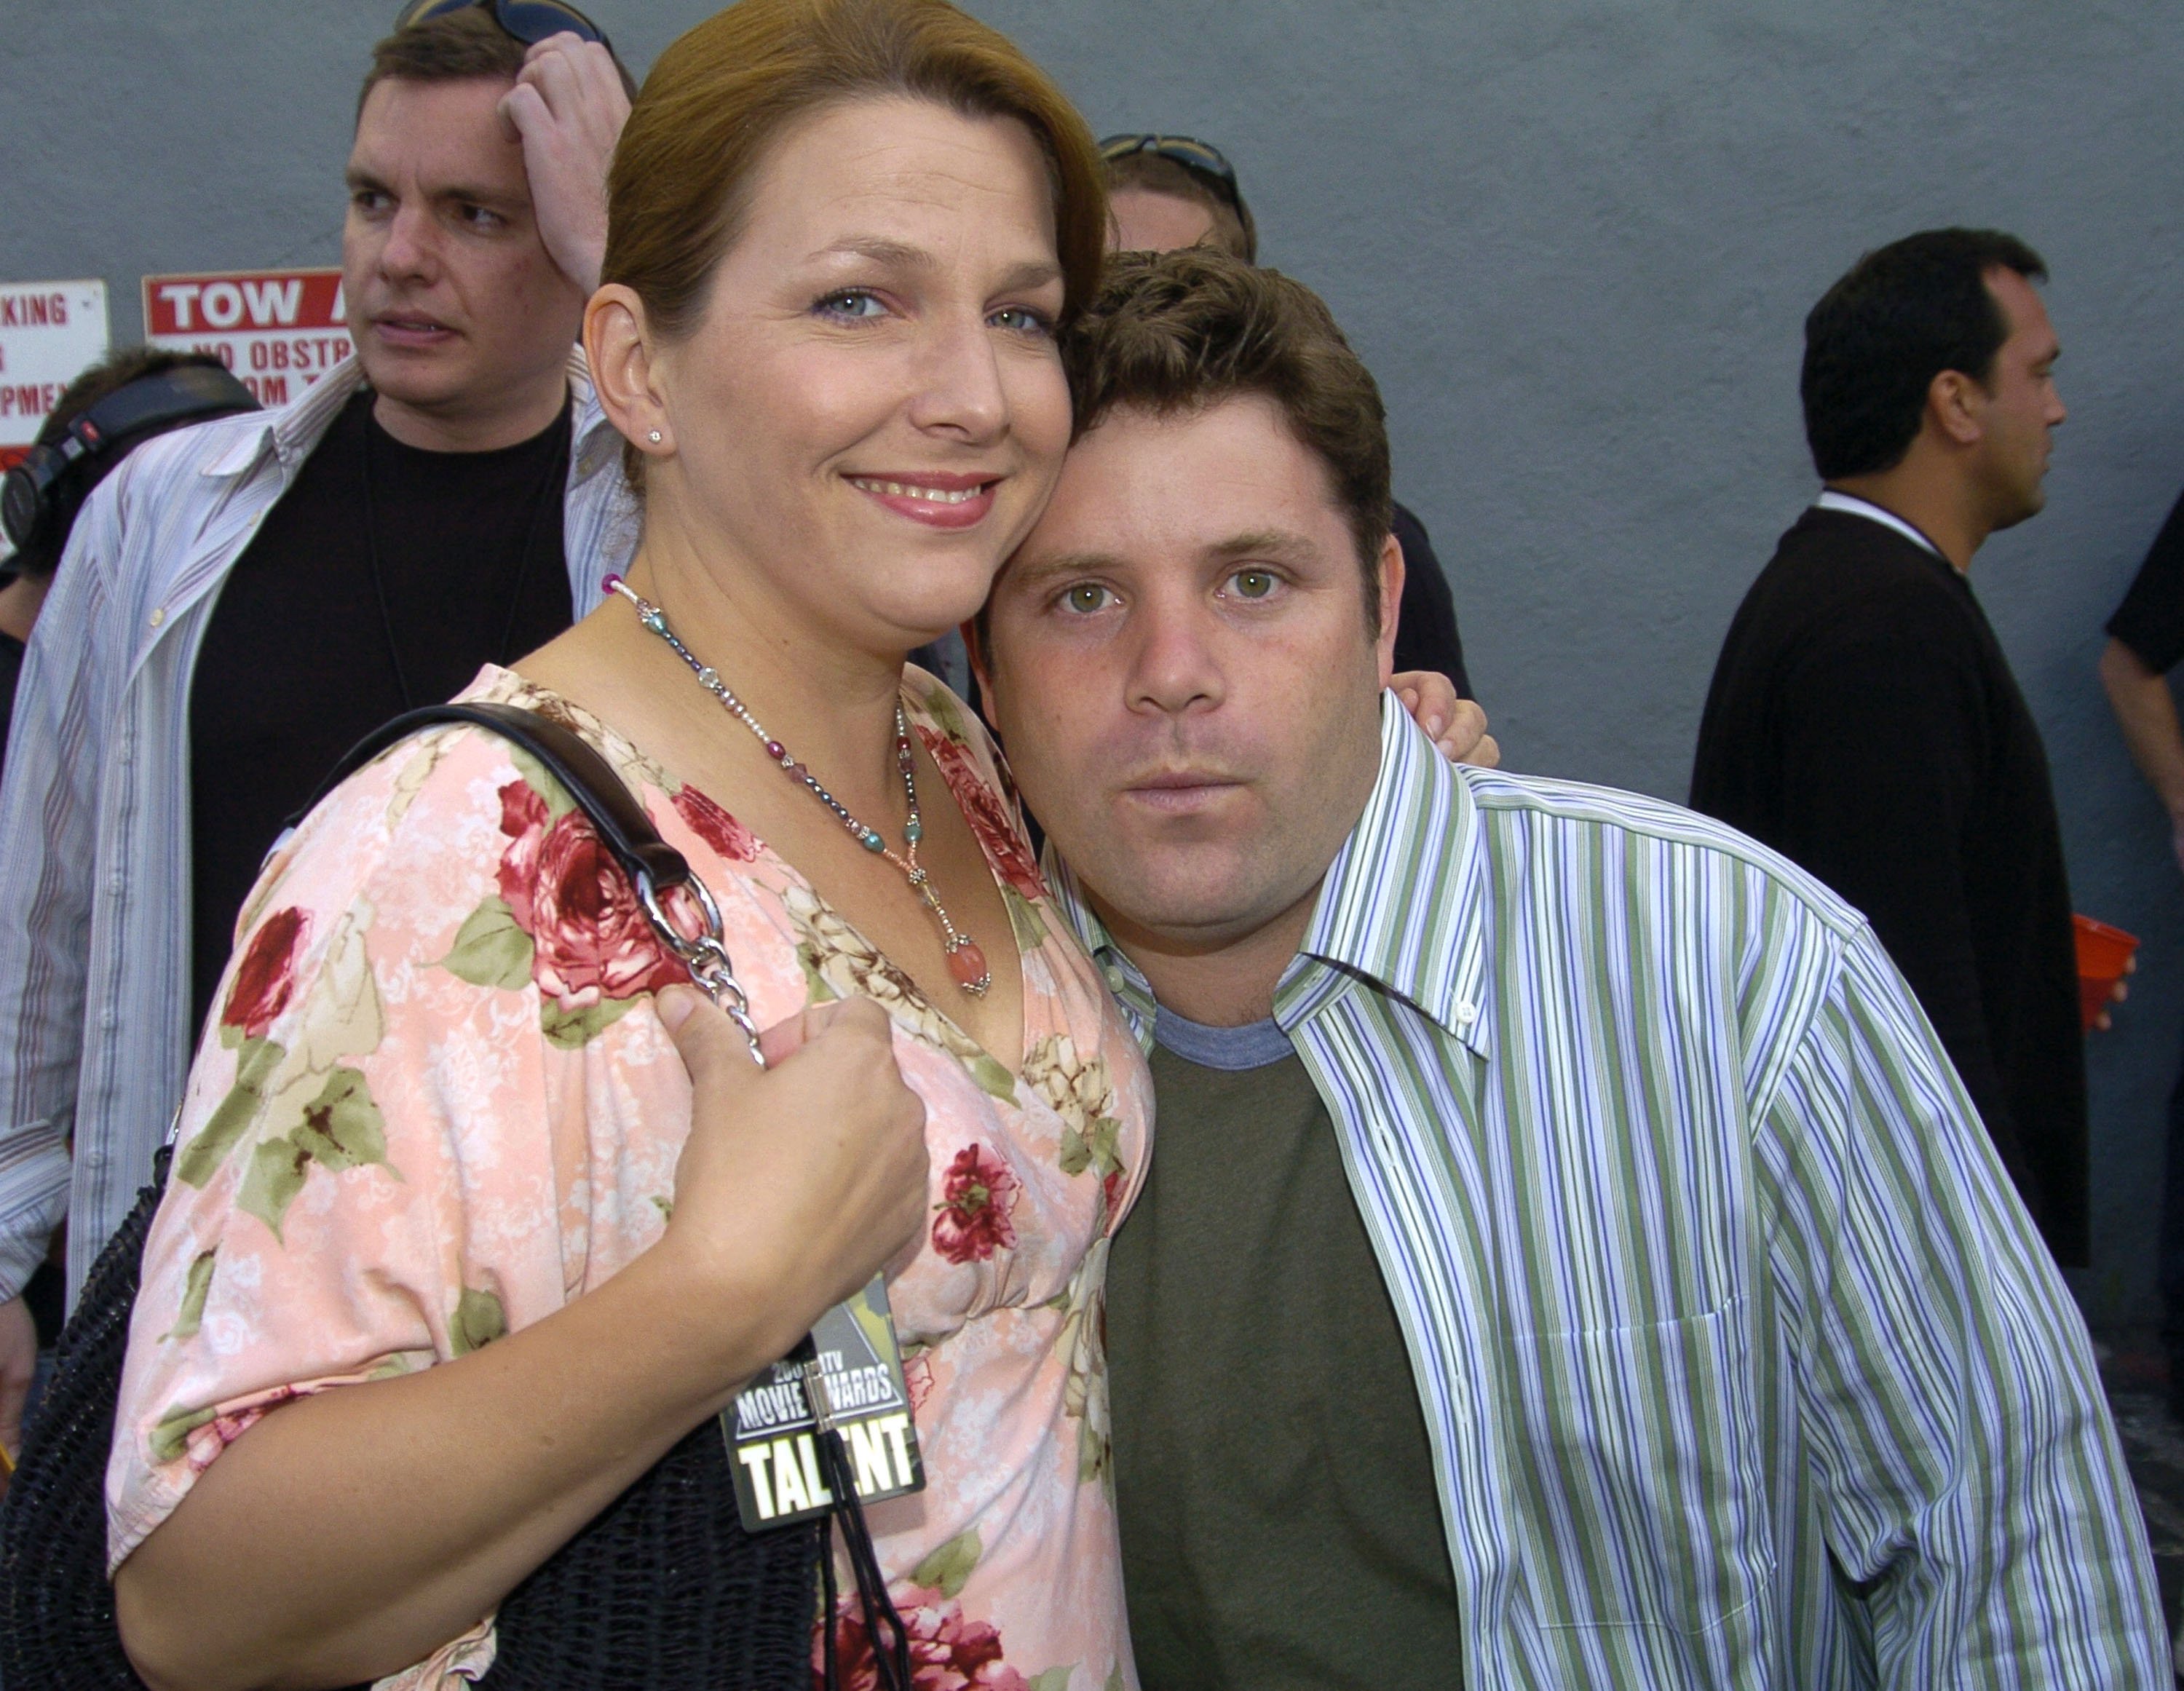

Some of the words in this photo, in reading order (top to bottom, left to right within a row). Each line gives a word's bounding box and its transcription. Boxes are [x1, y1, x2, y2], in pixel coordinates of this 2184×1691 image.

[159, 279, 302, 328] TOW
[735, 1382, 808, 1430] MOVIE
[823, 1363, 893, 1411] WARDS
